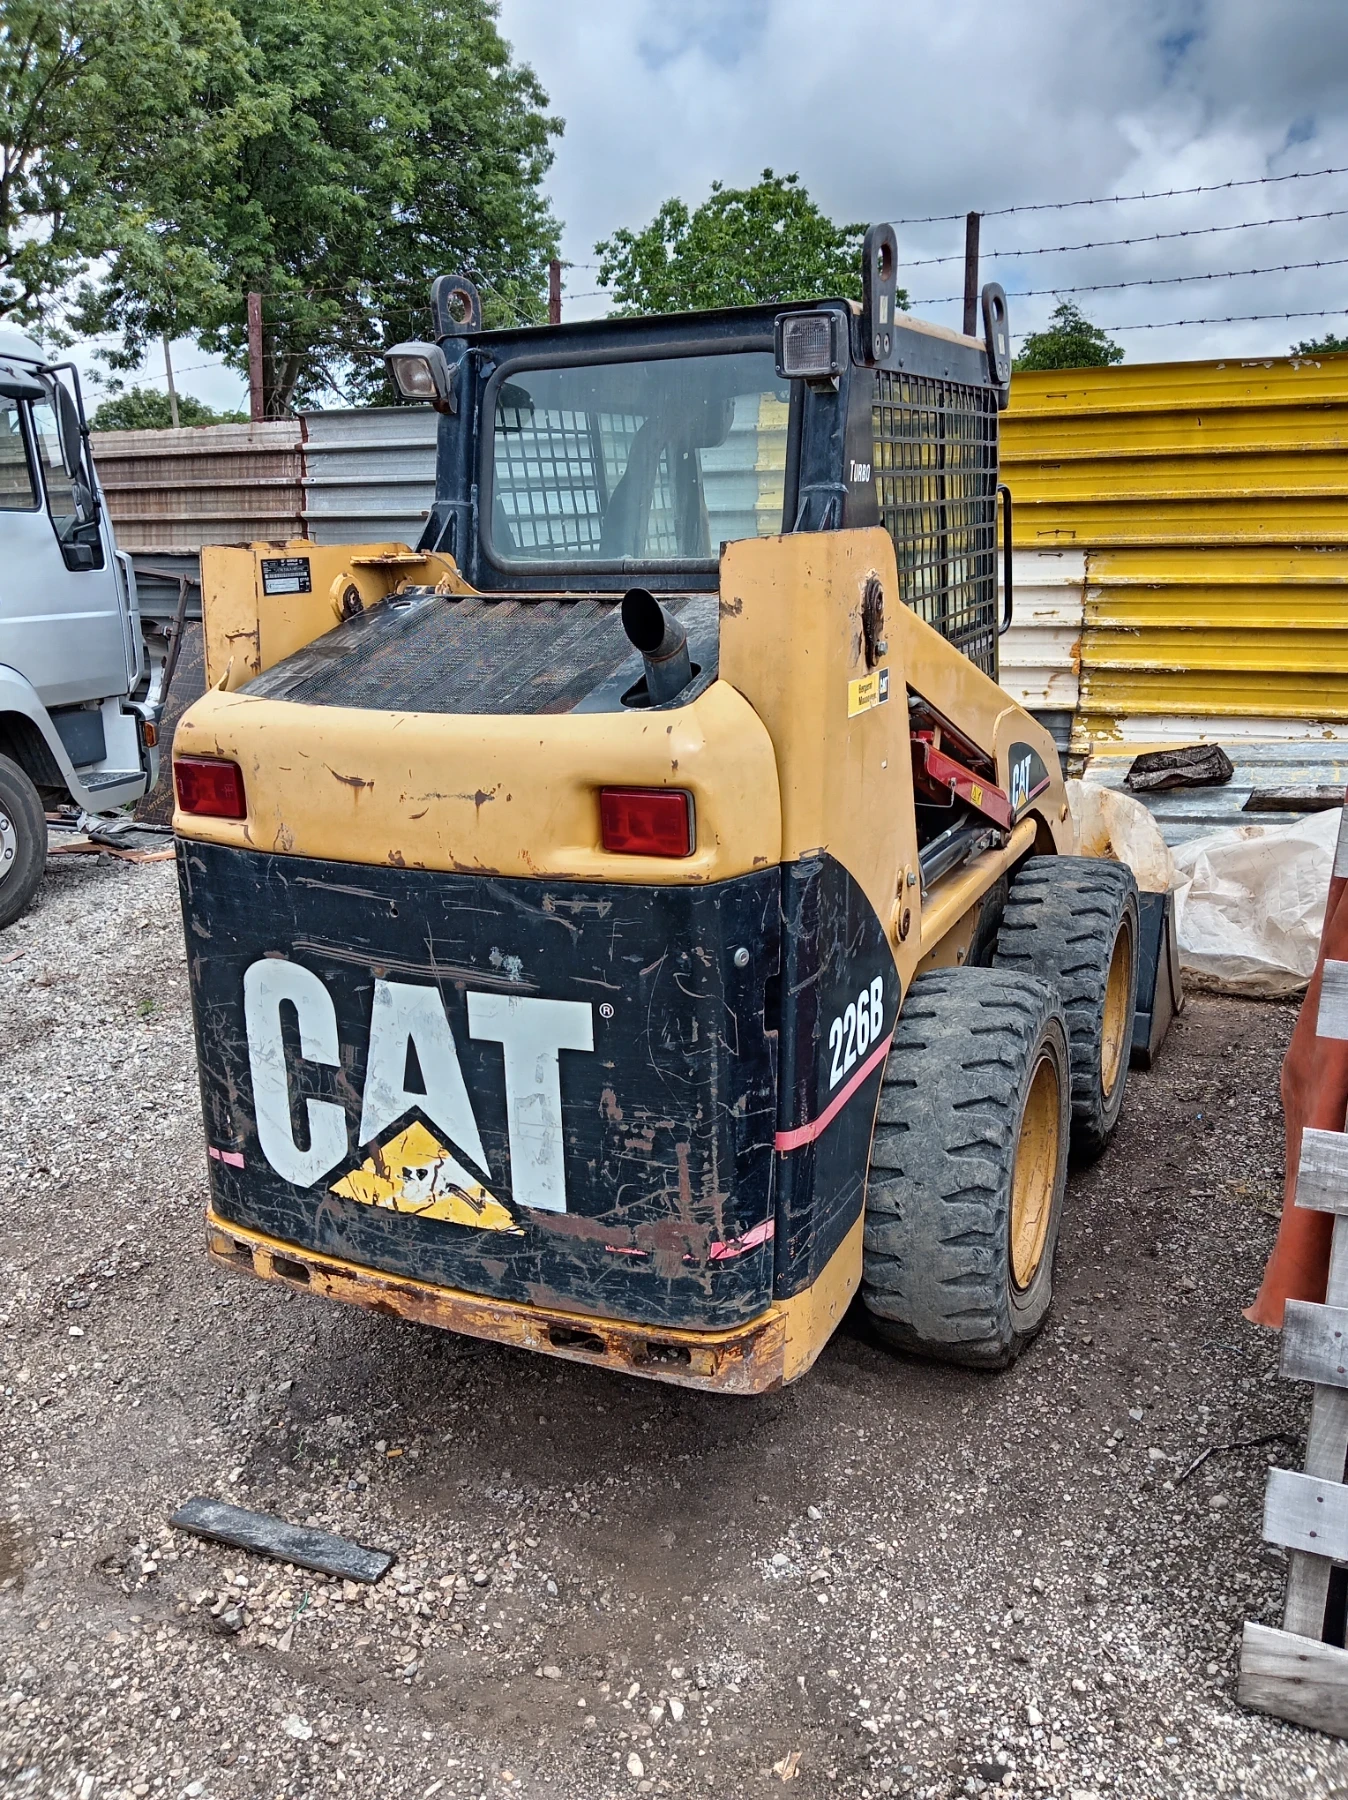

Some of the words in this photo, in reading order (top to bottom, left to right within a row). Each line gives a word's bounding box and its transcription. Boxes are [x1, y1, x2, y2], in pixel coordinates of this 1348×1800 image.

[1012, 753, 1032, 811] CAT
[243, 957, 595, 1214] CAT
[828, 975, 884, 1092] 226B
